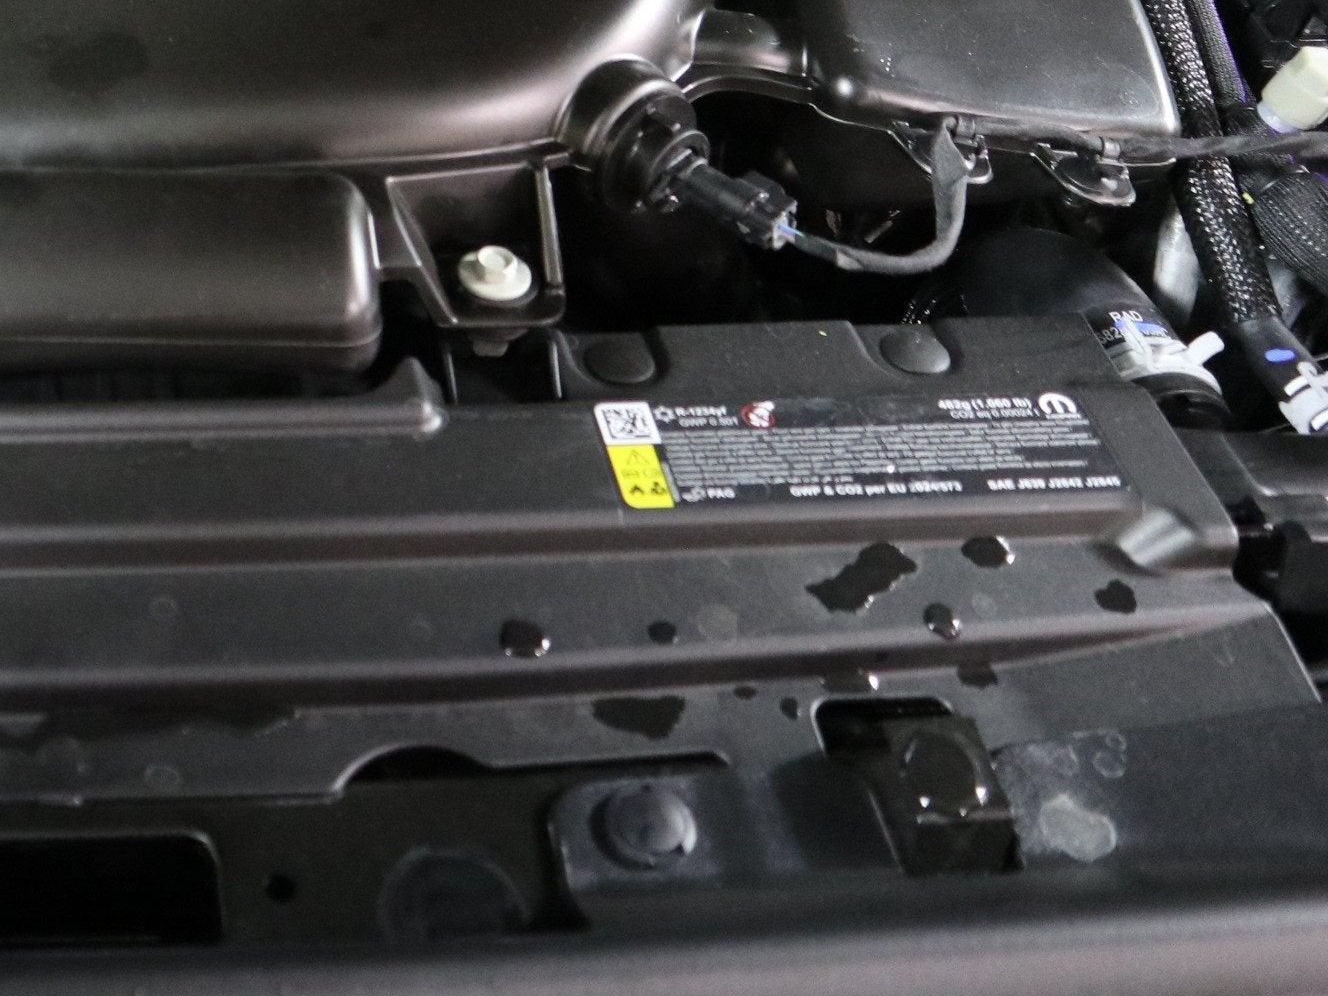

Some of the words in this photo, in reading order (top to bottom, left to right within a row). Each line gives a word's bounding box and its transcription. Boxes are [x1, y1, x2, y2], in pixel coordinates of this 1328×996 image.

[1108, 310, 1144, 323] RAD
[1011, 397, 1032, 409] lb)
[789, 484, 821, 497] GWP
[835, 483, 863, 495] CO2
[886, 481, 907, 494] EU
[987, 478, 1016, 491] SAE
[706, 486, 736, 499] PAG
